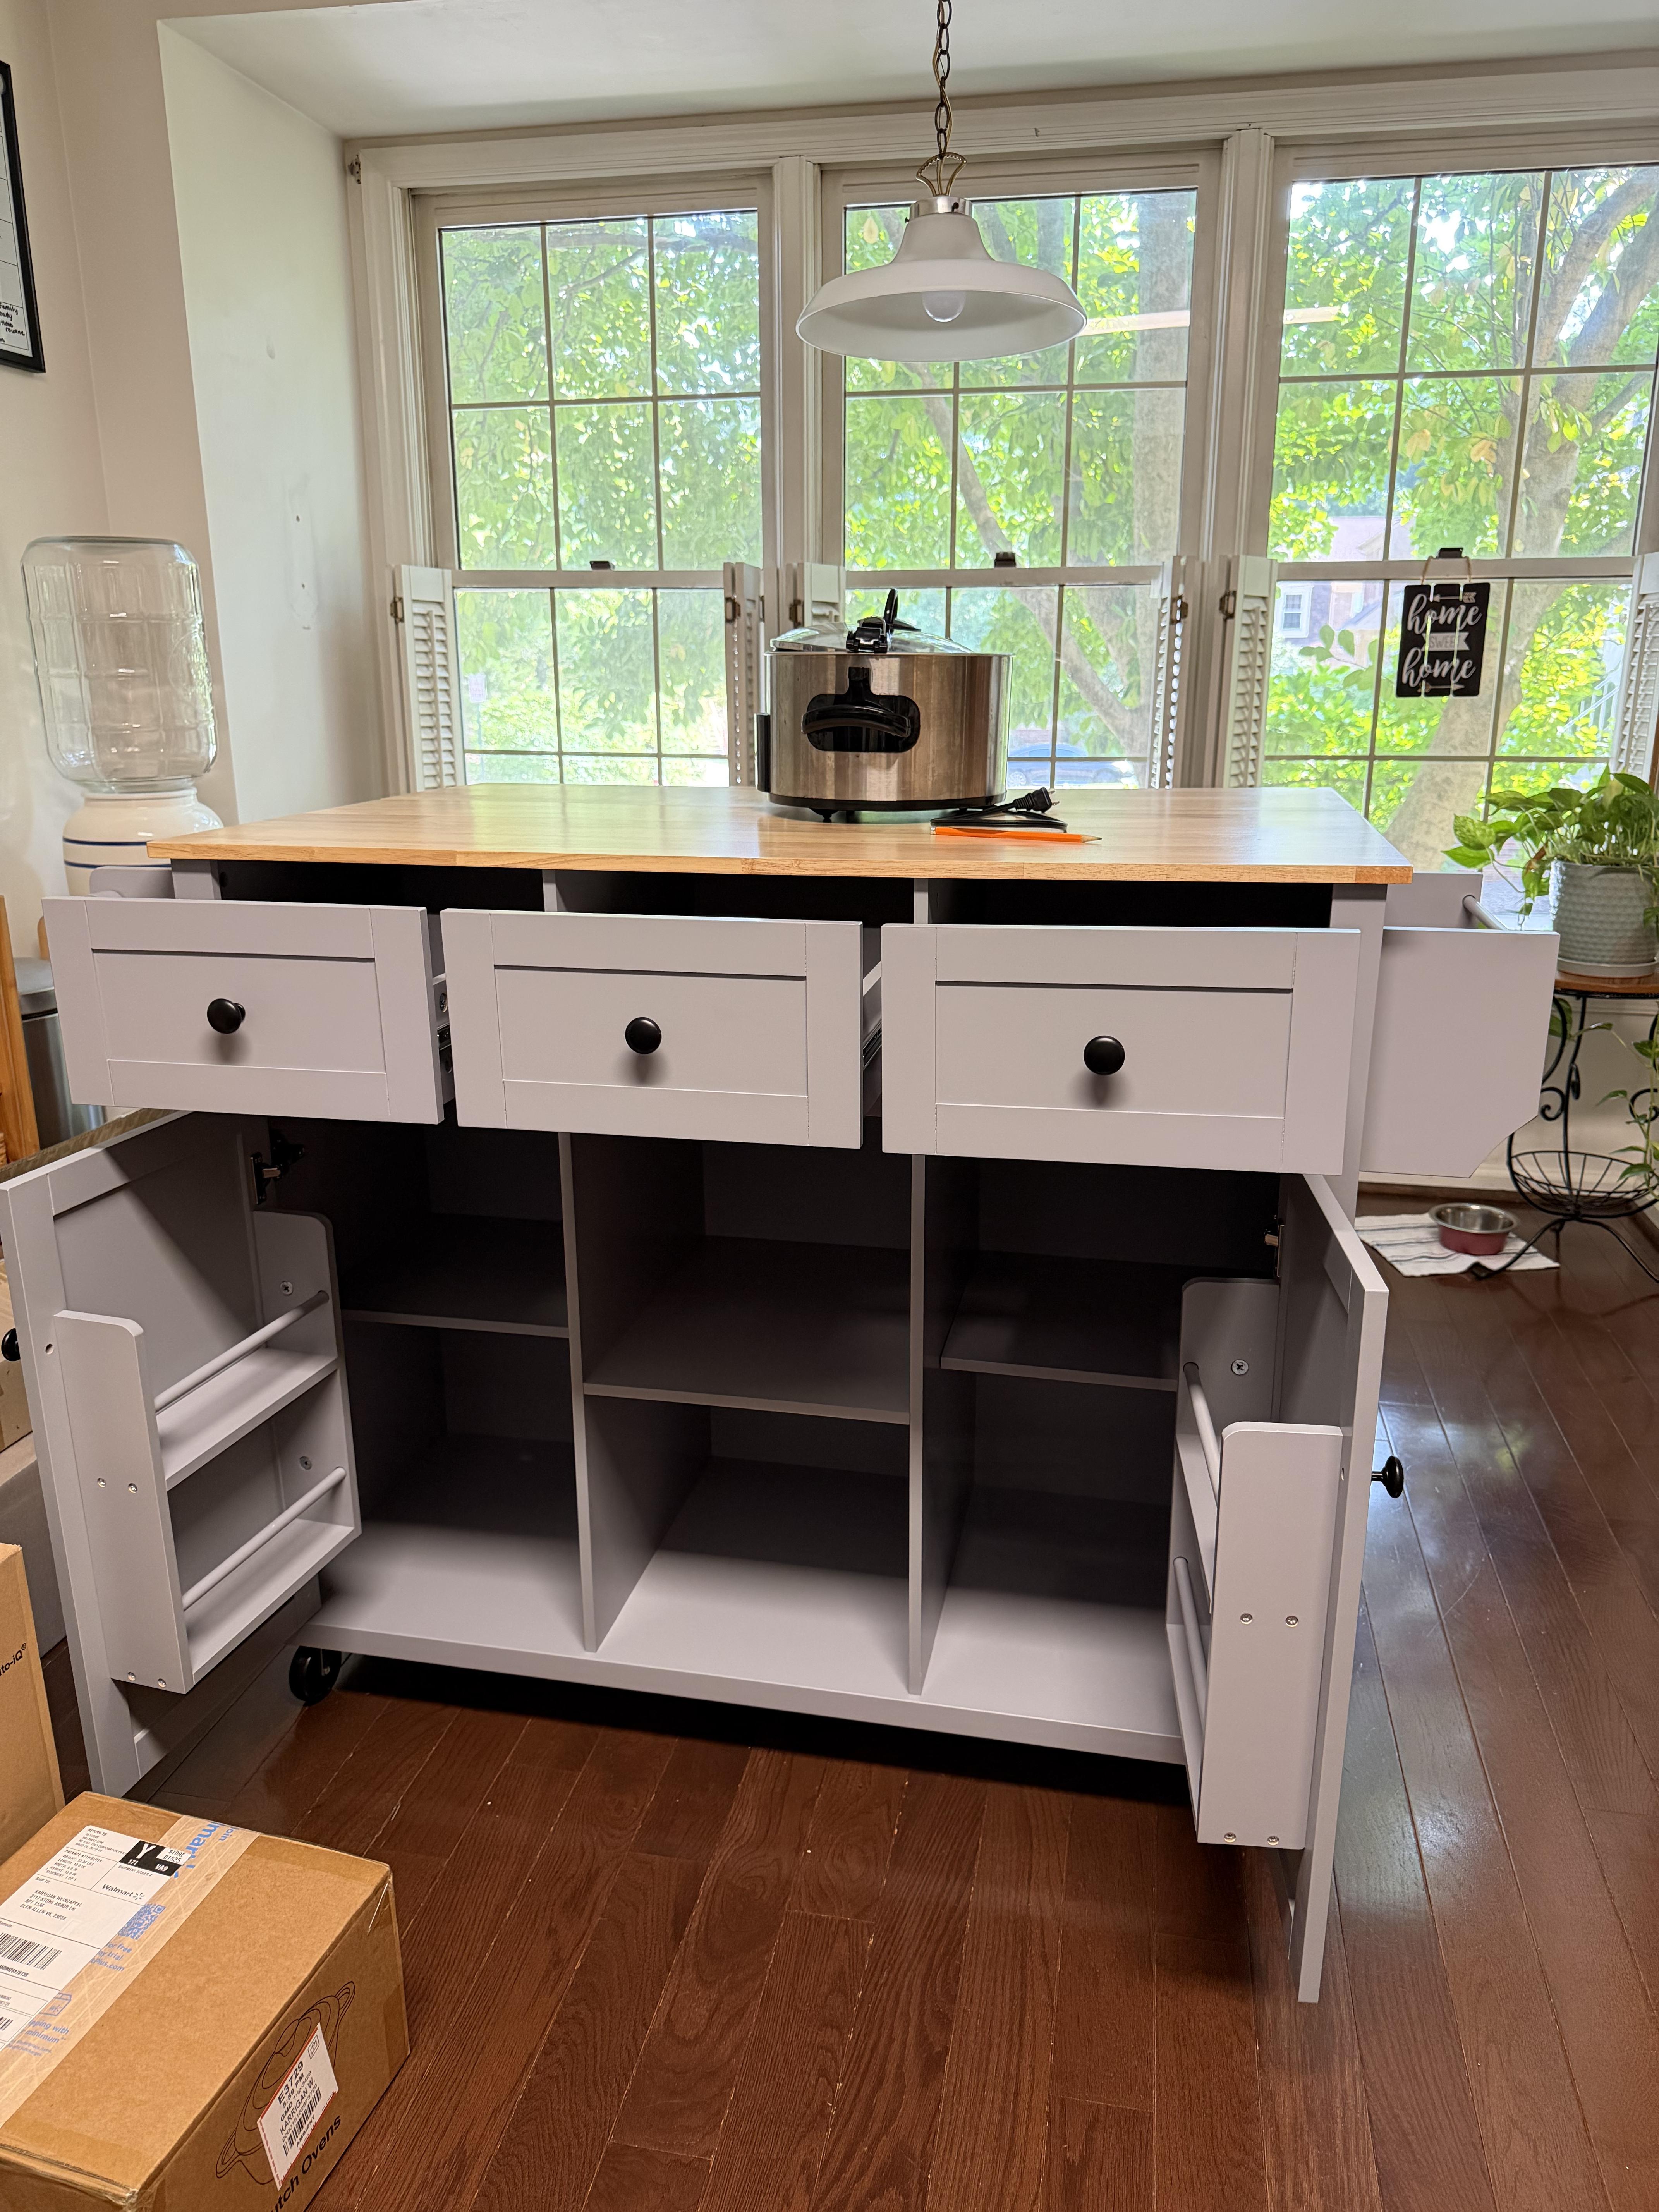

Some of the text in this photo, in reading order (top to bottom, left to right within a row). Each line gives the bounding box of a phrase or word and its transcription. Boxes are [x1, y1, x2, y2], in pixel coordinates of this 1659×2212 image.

[0, 319, 14, 328] time
[1407, 593, 1482, 635] home
[1401, 647, 1476, 687] home
[186, 1822, 225, 1858] mar
[218, 1828, 234, 1841] oin
[136, 1843, 156, 1859] Y
[35, 1890, 56, 1899] KARRIGAN
[102, 1884, 133, 1897] Walmart
[107, 1951, 124, 1960] trial
[117, 1943, 132, 1953] free
[29, 2019, 69, 2035] pping with
[278, 2061, 303, 2105] E3729
[283, 2073, 304, 2108] 5:59 PM
[280, 2077, 315, 2135] KARRIGAN W.
[281, 2102, 292, 2121] GMD
[297, 2114, 314, 2147] AMBIENT
[302, 2115, 341, 2174] Ovens
